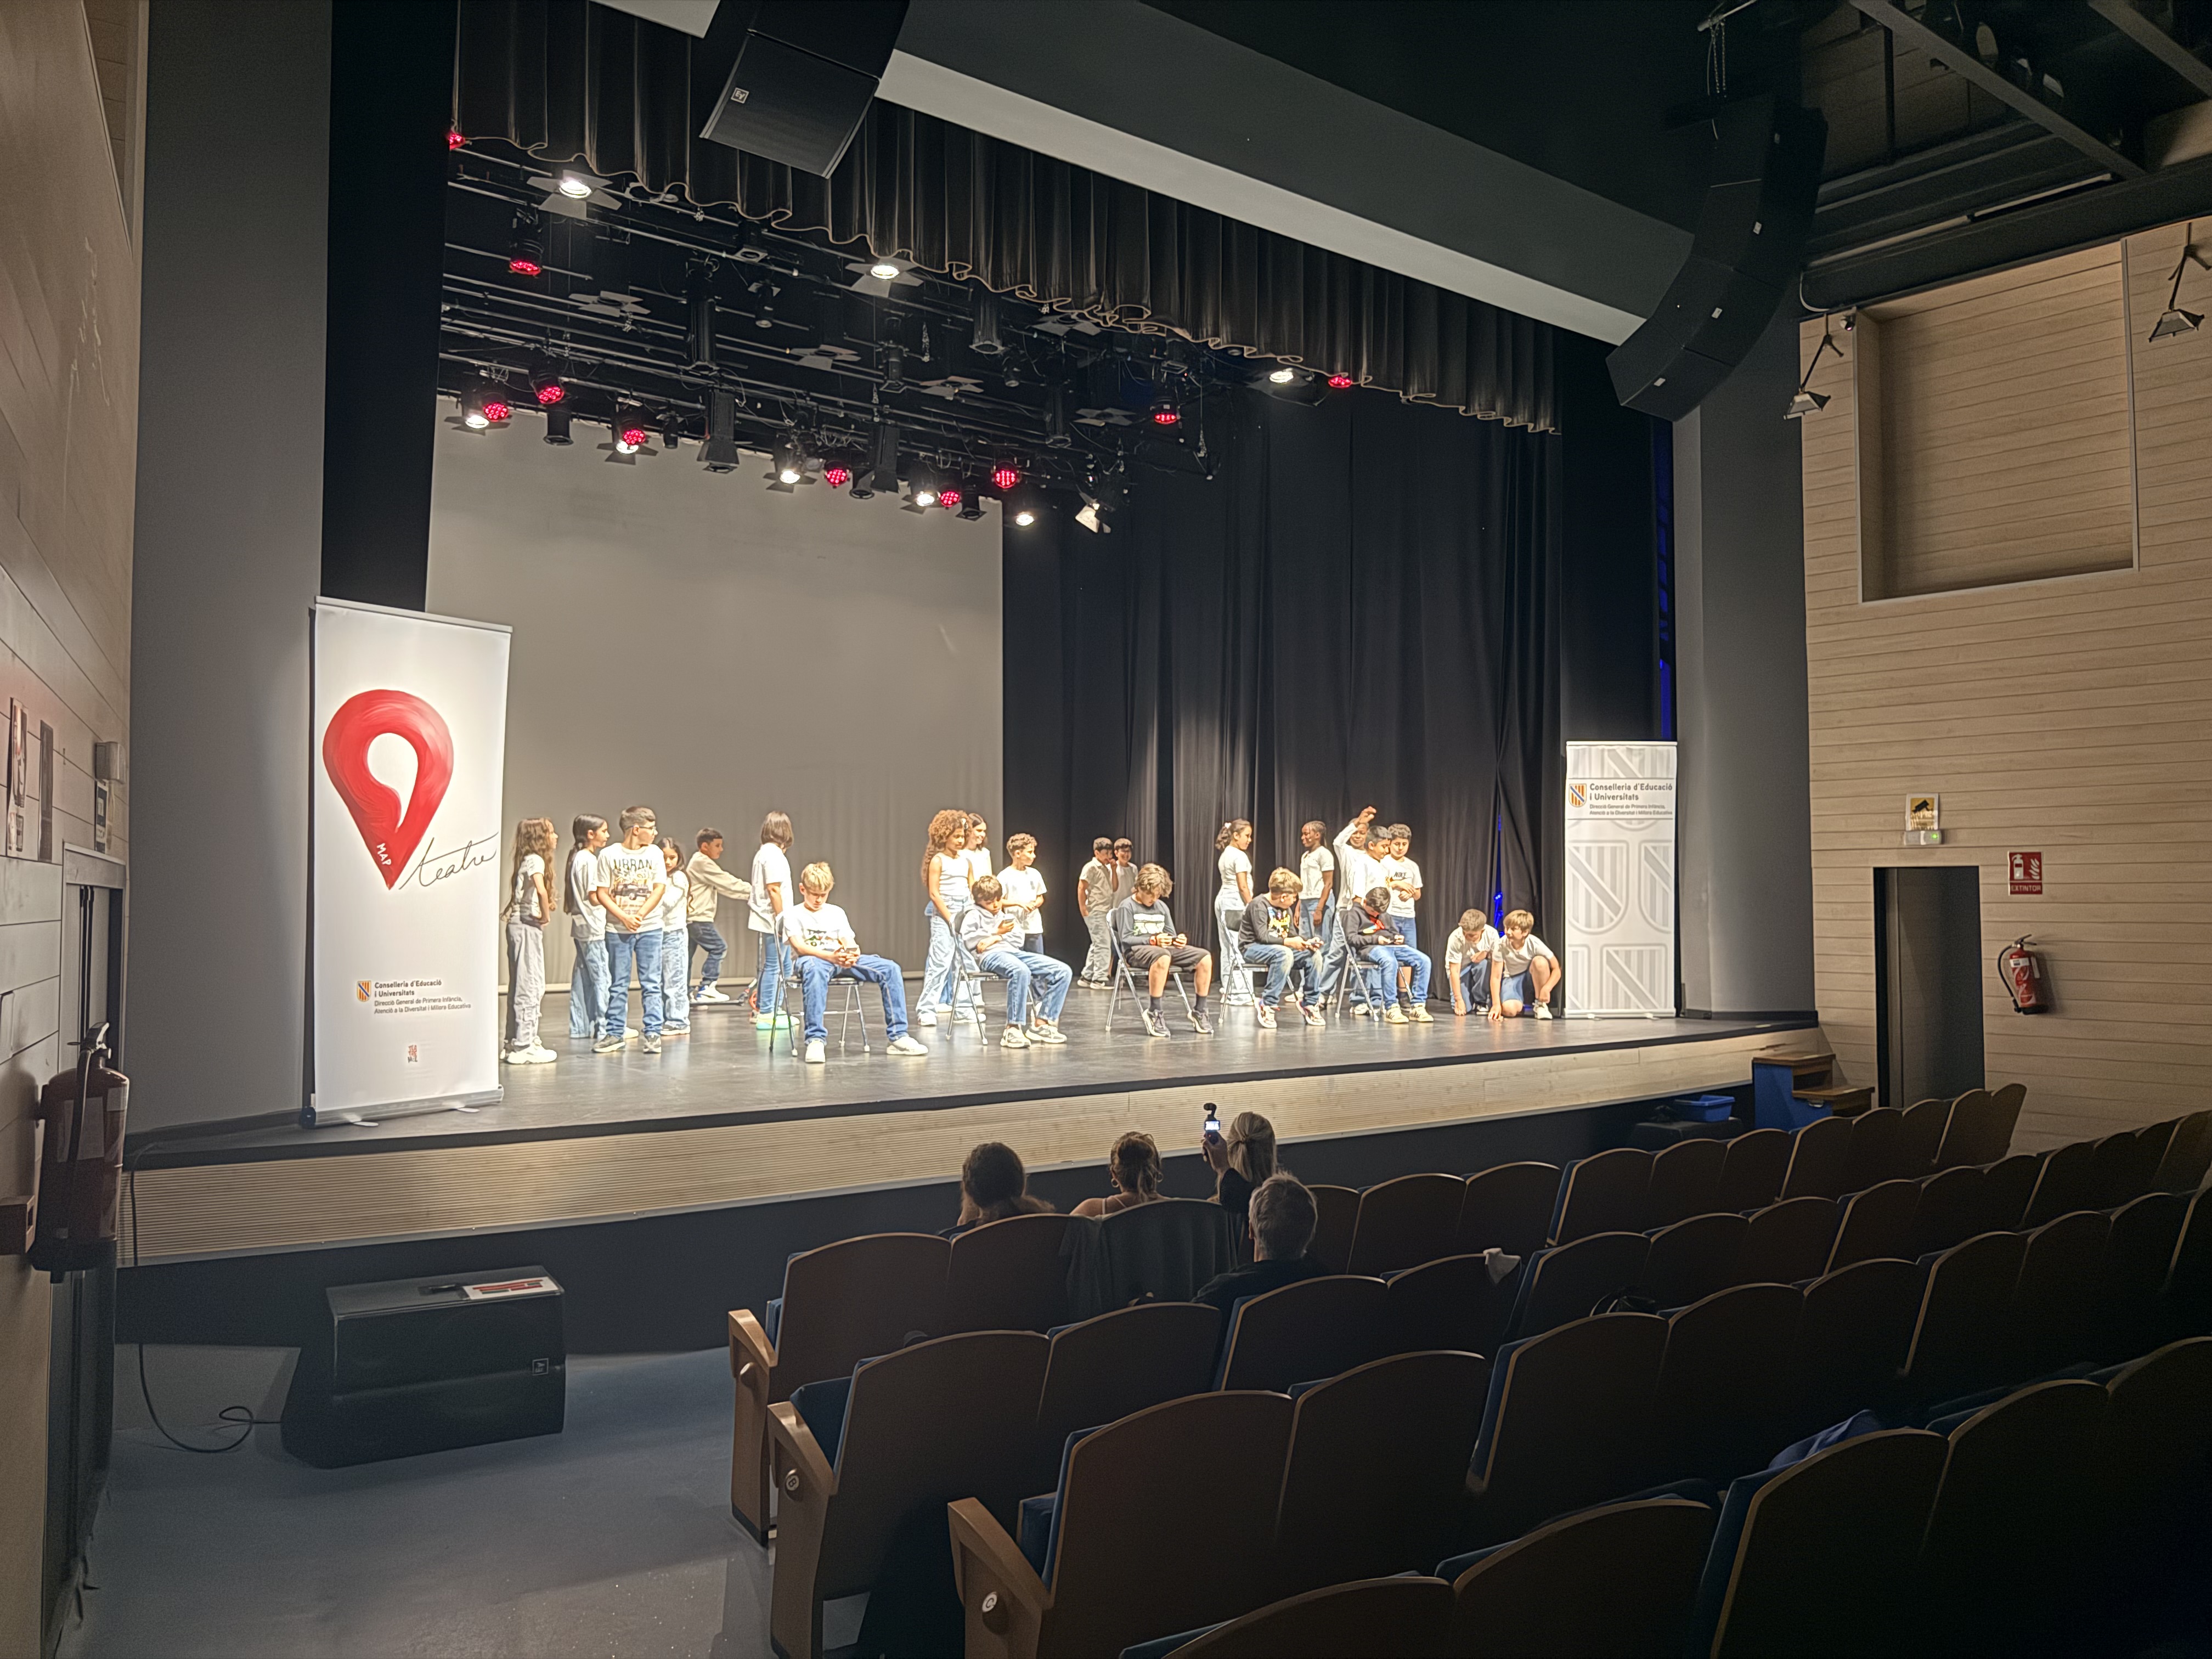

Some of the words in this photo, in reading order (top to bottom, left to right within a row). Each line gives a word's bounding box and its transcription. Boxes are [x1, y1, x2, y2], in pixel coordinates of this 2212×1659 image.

[1589, 783, 1631, 791] Conselleria
[1633, 783, 1673, 791] d'Educació
[376, 843, 392, 866] MAP
[398, 831, 499, 890] teatre
[613, 859, 652, 871] URBAN
[374, 980, 409, 989] Conselleria
[410, 979, 442, 988] d'Educació
